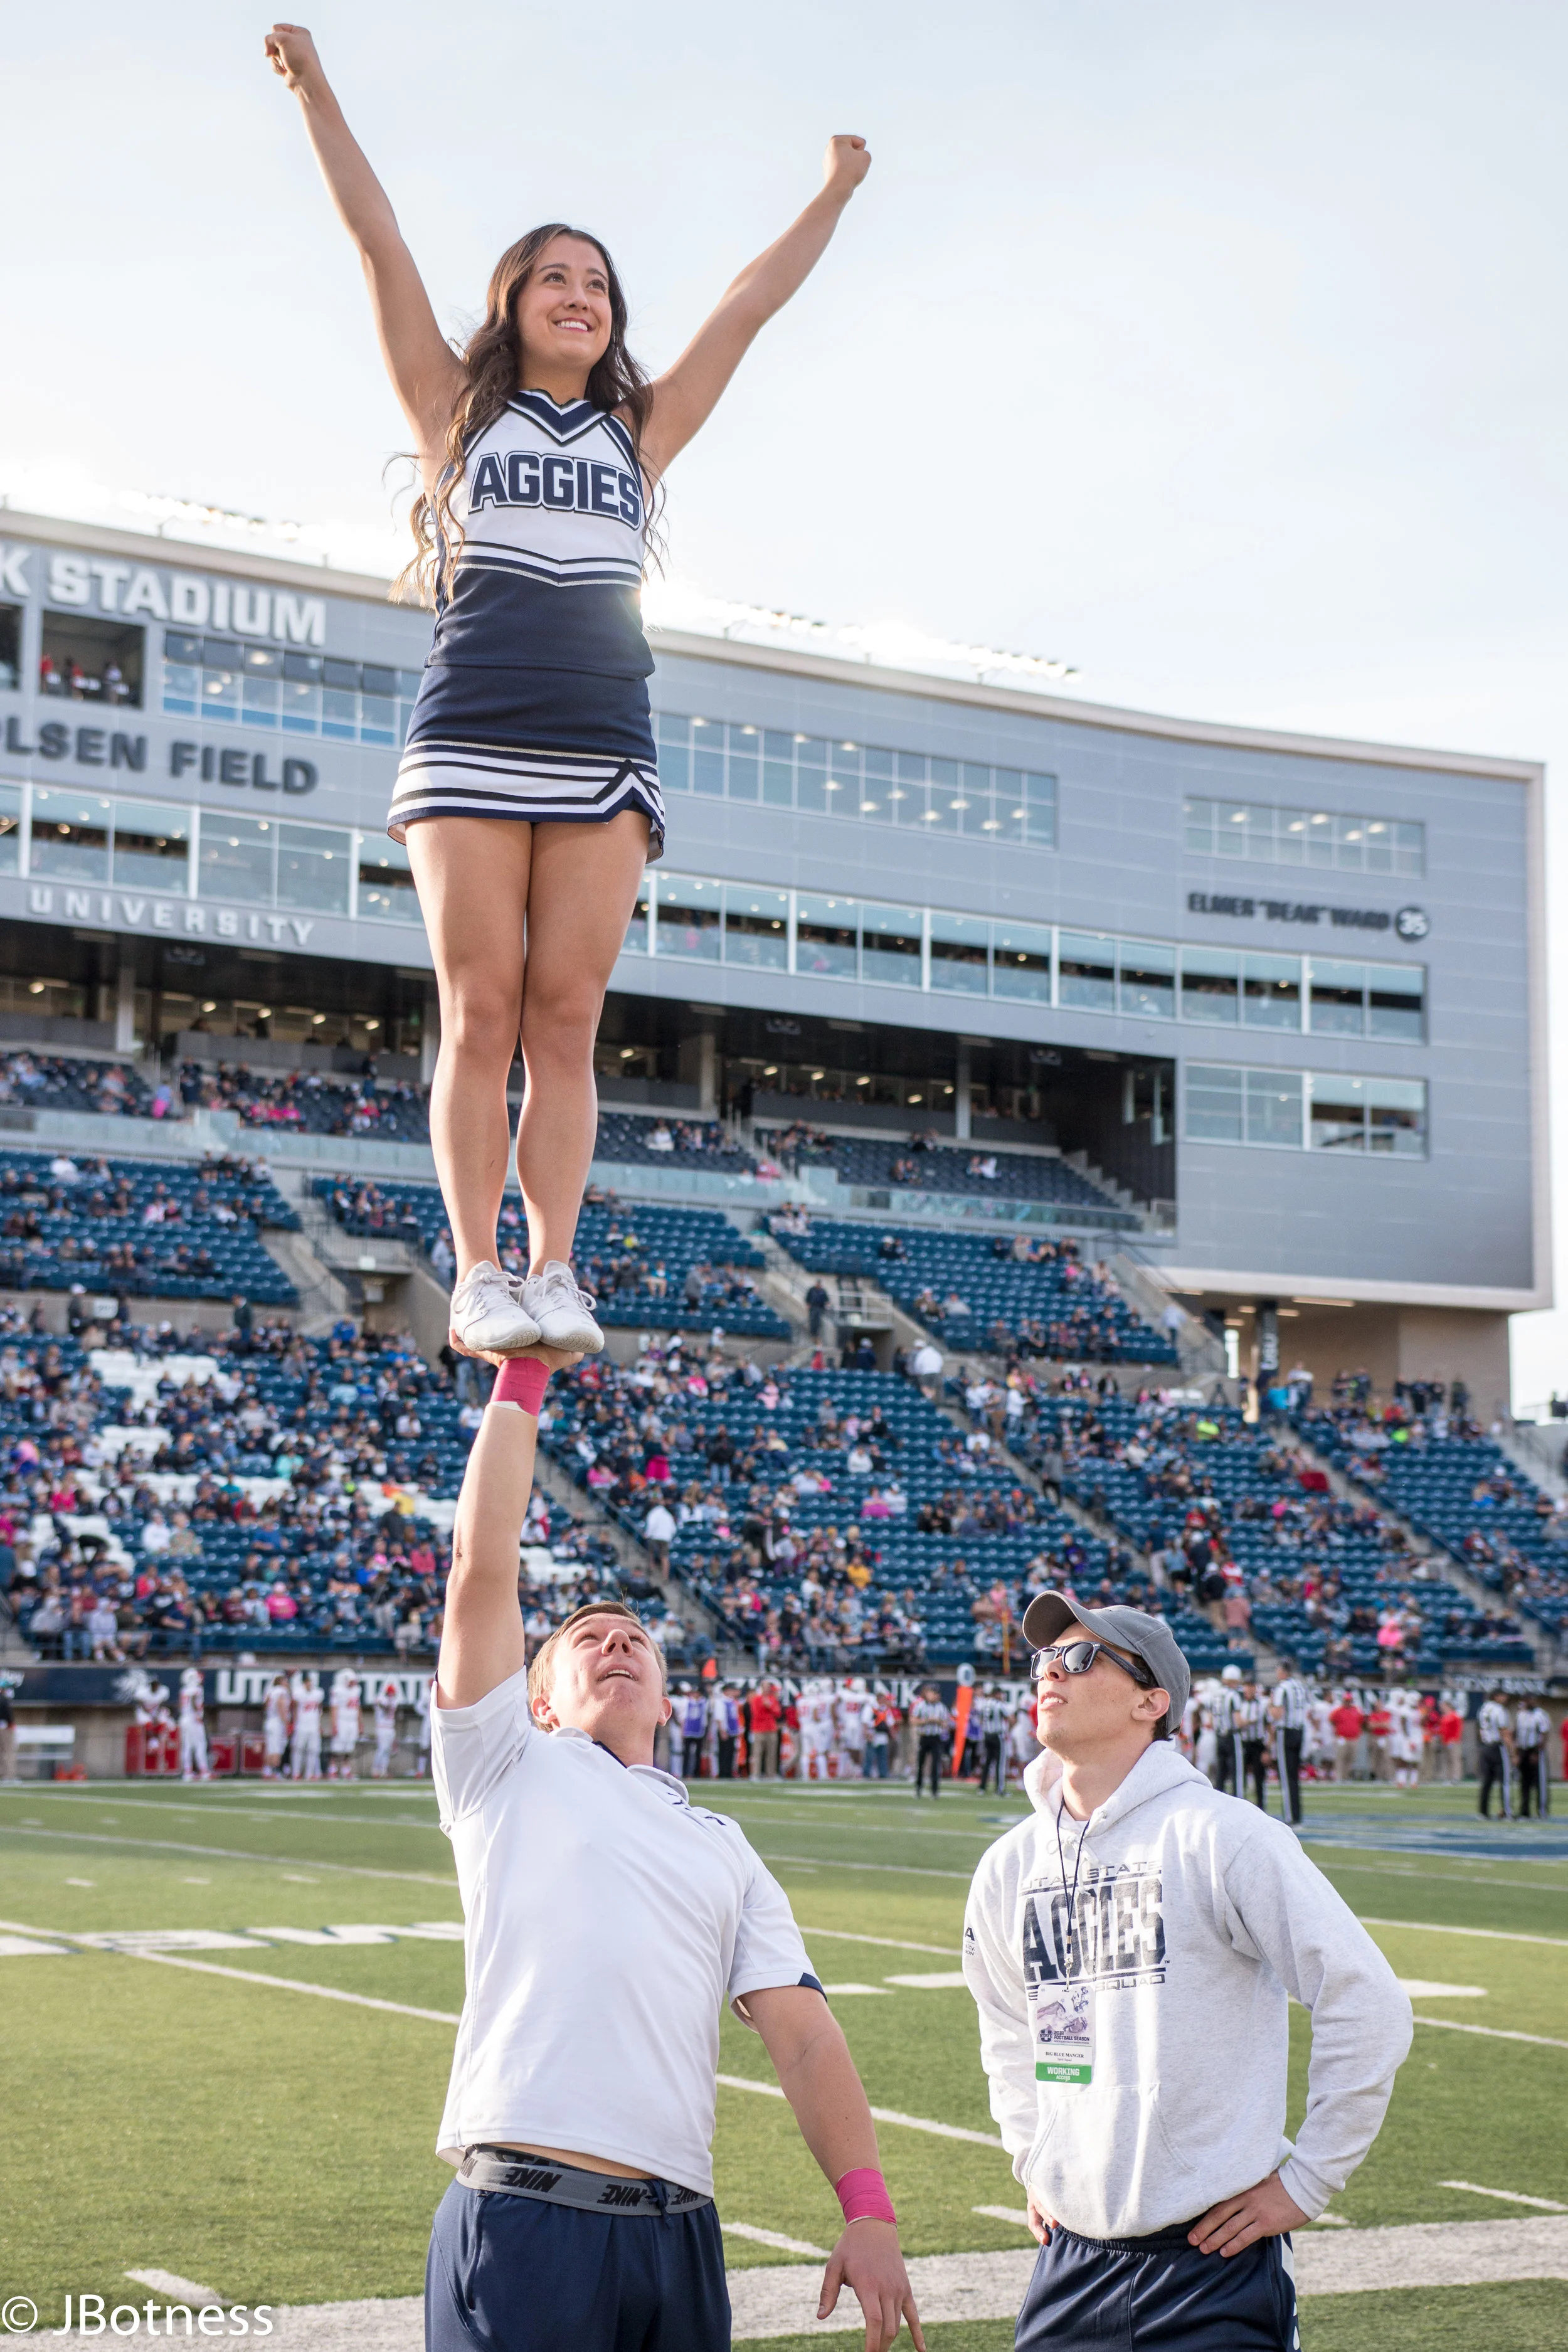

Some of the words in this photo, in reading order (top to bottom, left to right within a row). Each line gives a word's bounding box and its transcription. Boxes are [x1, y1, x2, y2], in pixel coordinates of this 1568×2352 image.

[469, 451, 641, 531] AGGIES
[50, 553, 326, 647] STADIUM
[6, 714, 148, 773] LSEN
[169, 740, 319, 794] FIELD
[30, 888, 315, 946] UNIVERSITY
[1088, 1861, 1162, 1878] STATE
[1023, 1878, 1166, 1983] AGGIES
[1095, 1974, 1165, 1991] SQUAD
[1047, 2066, 1080, 2076] WORKING
[500, 2166, 563, 2193] NIKE
[596, 2184, 648, 2207] NIKE
